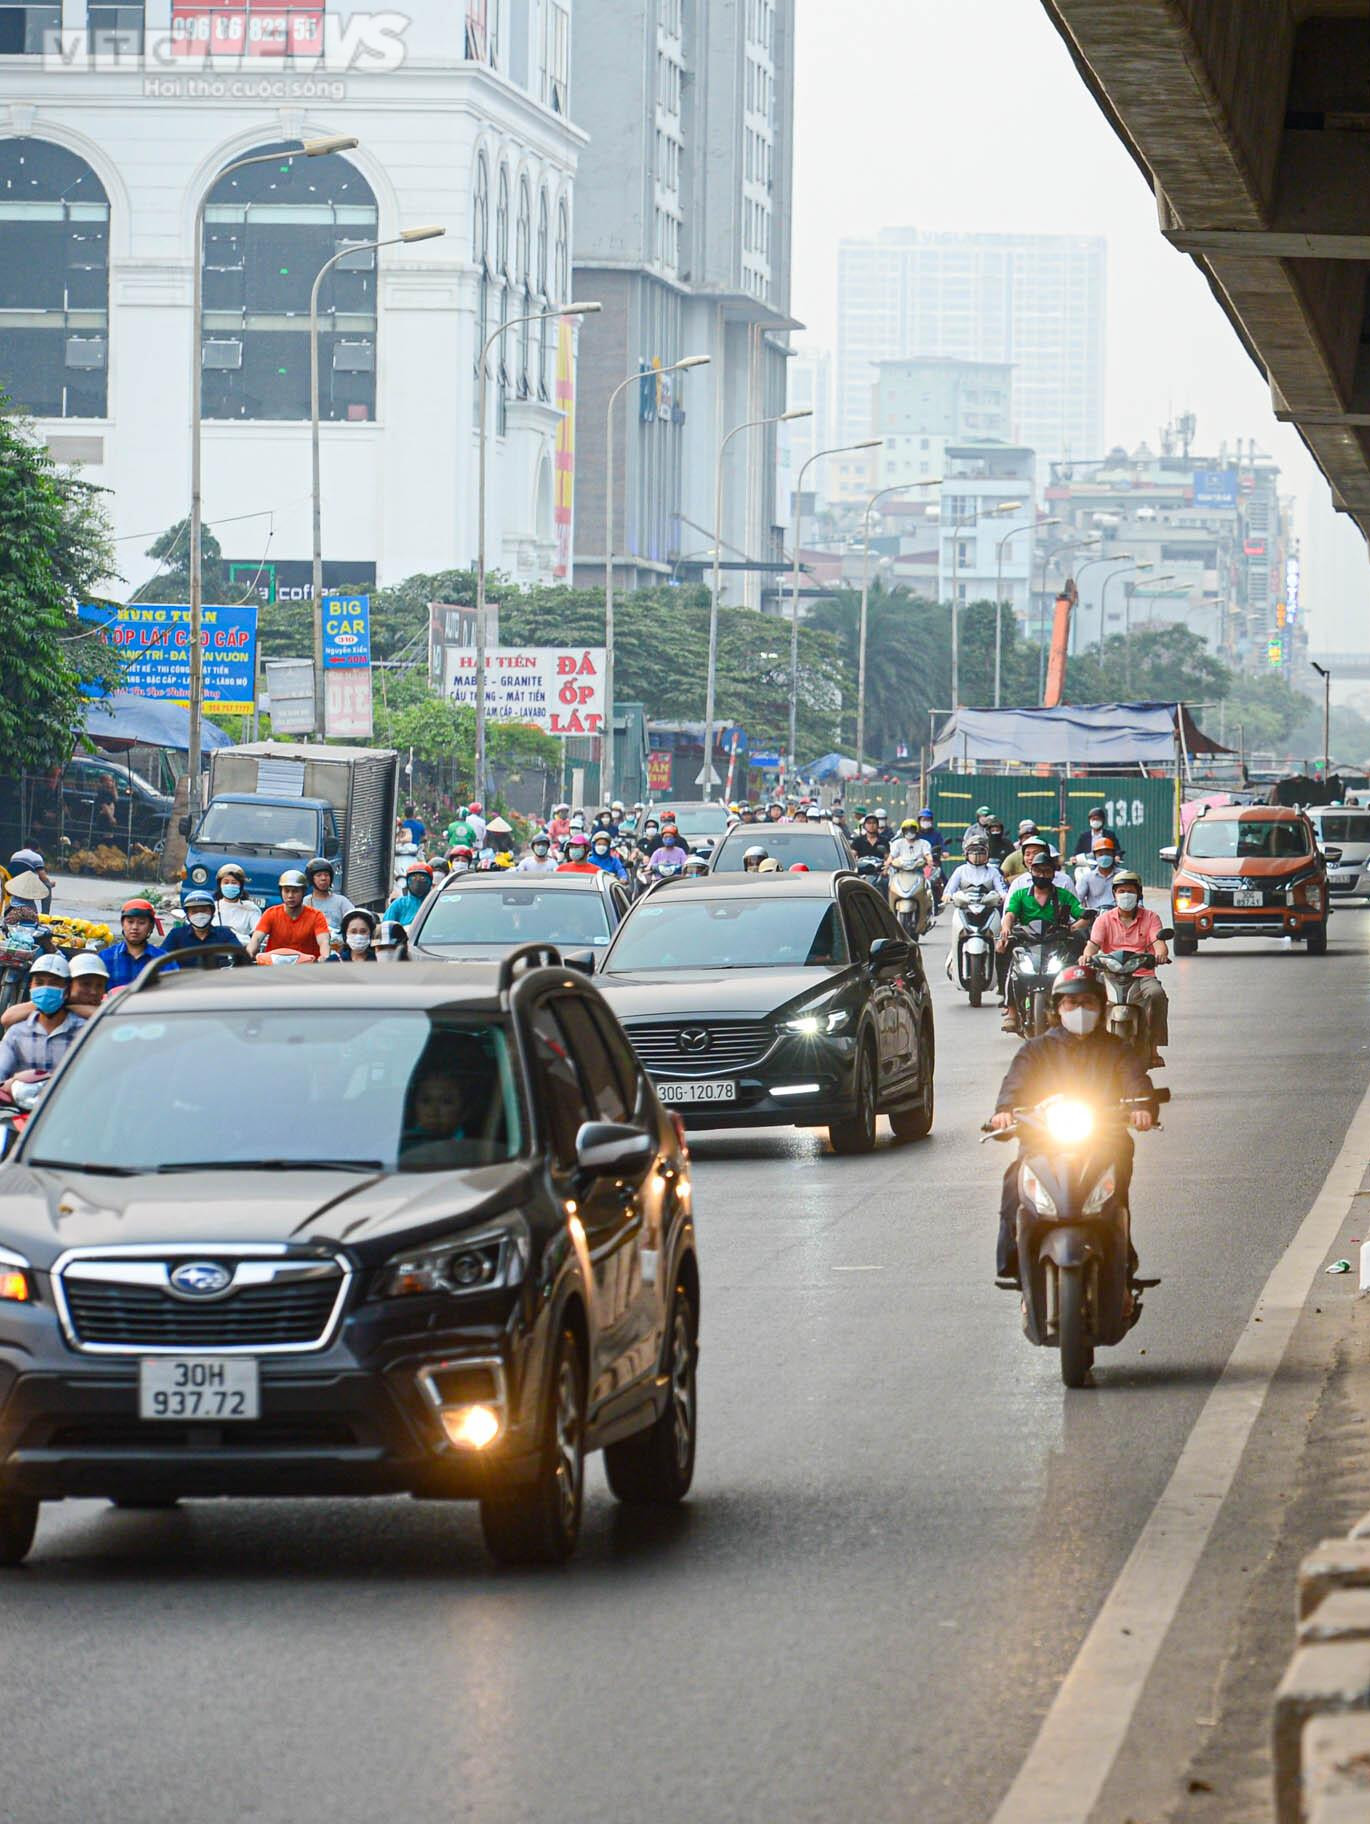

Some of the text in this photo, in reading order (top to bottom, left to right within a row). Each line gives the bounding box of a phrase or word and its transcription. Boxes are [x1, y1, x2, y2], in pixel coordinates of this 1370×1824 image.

[329, 600, 362, 616] BIG
[326, 619, 366, 635] CAR
[175, 630, 210, 647] CO
[500, 676, 543, 687] GRANITE
[658, 1083, 734, 1101] 30G-120.78
[174, 1363, 225, 1387] 30H
[153, 1391, 246, 1416] 937.72
